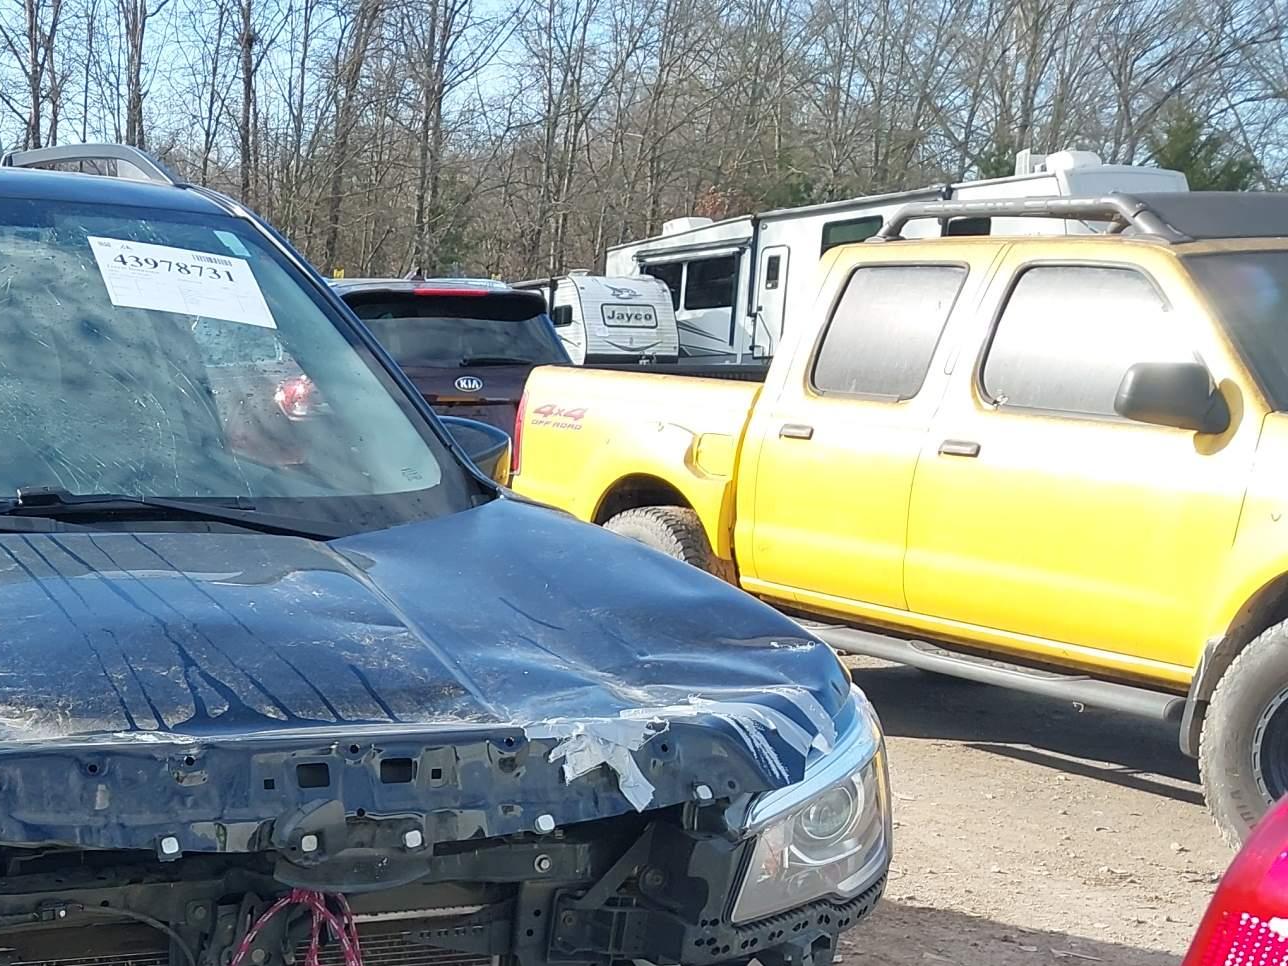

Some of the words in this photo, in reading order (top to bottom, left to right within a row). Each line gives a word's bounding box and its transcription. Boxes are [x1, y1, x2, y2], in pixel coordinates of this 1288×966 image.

[113, 253, 234, 282] 43978731
[607, 310, 652, 322] Jayco
[552, 422, 582, 430] ROAD
